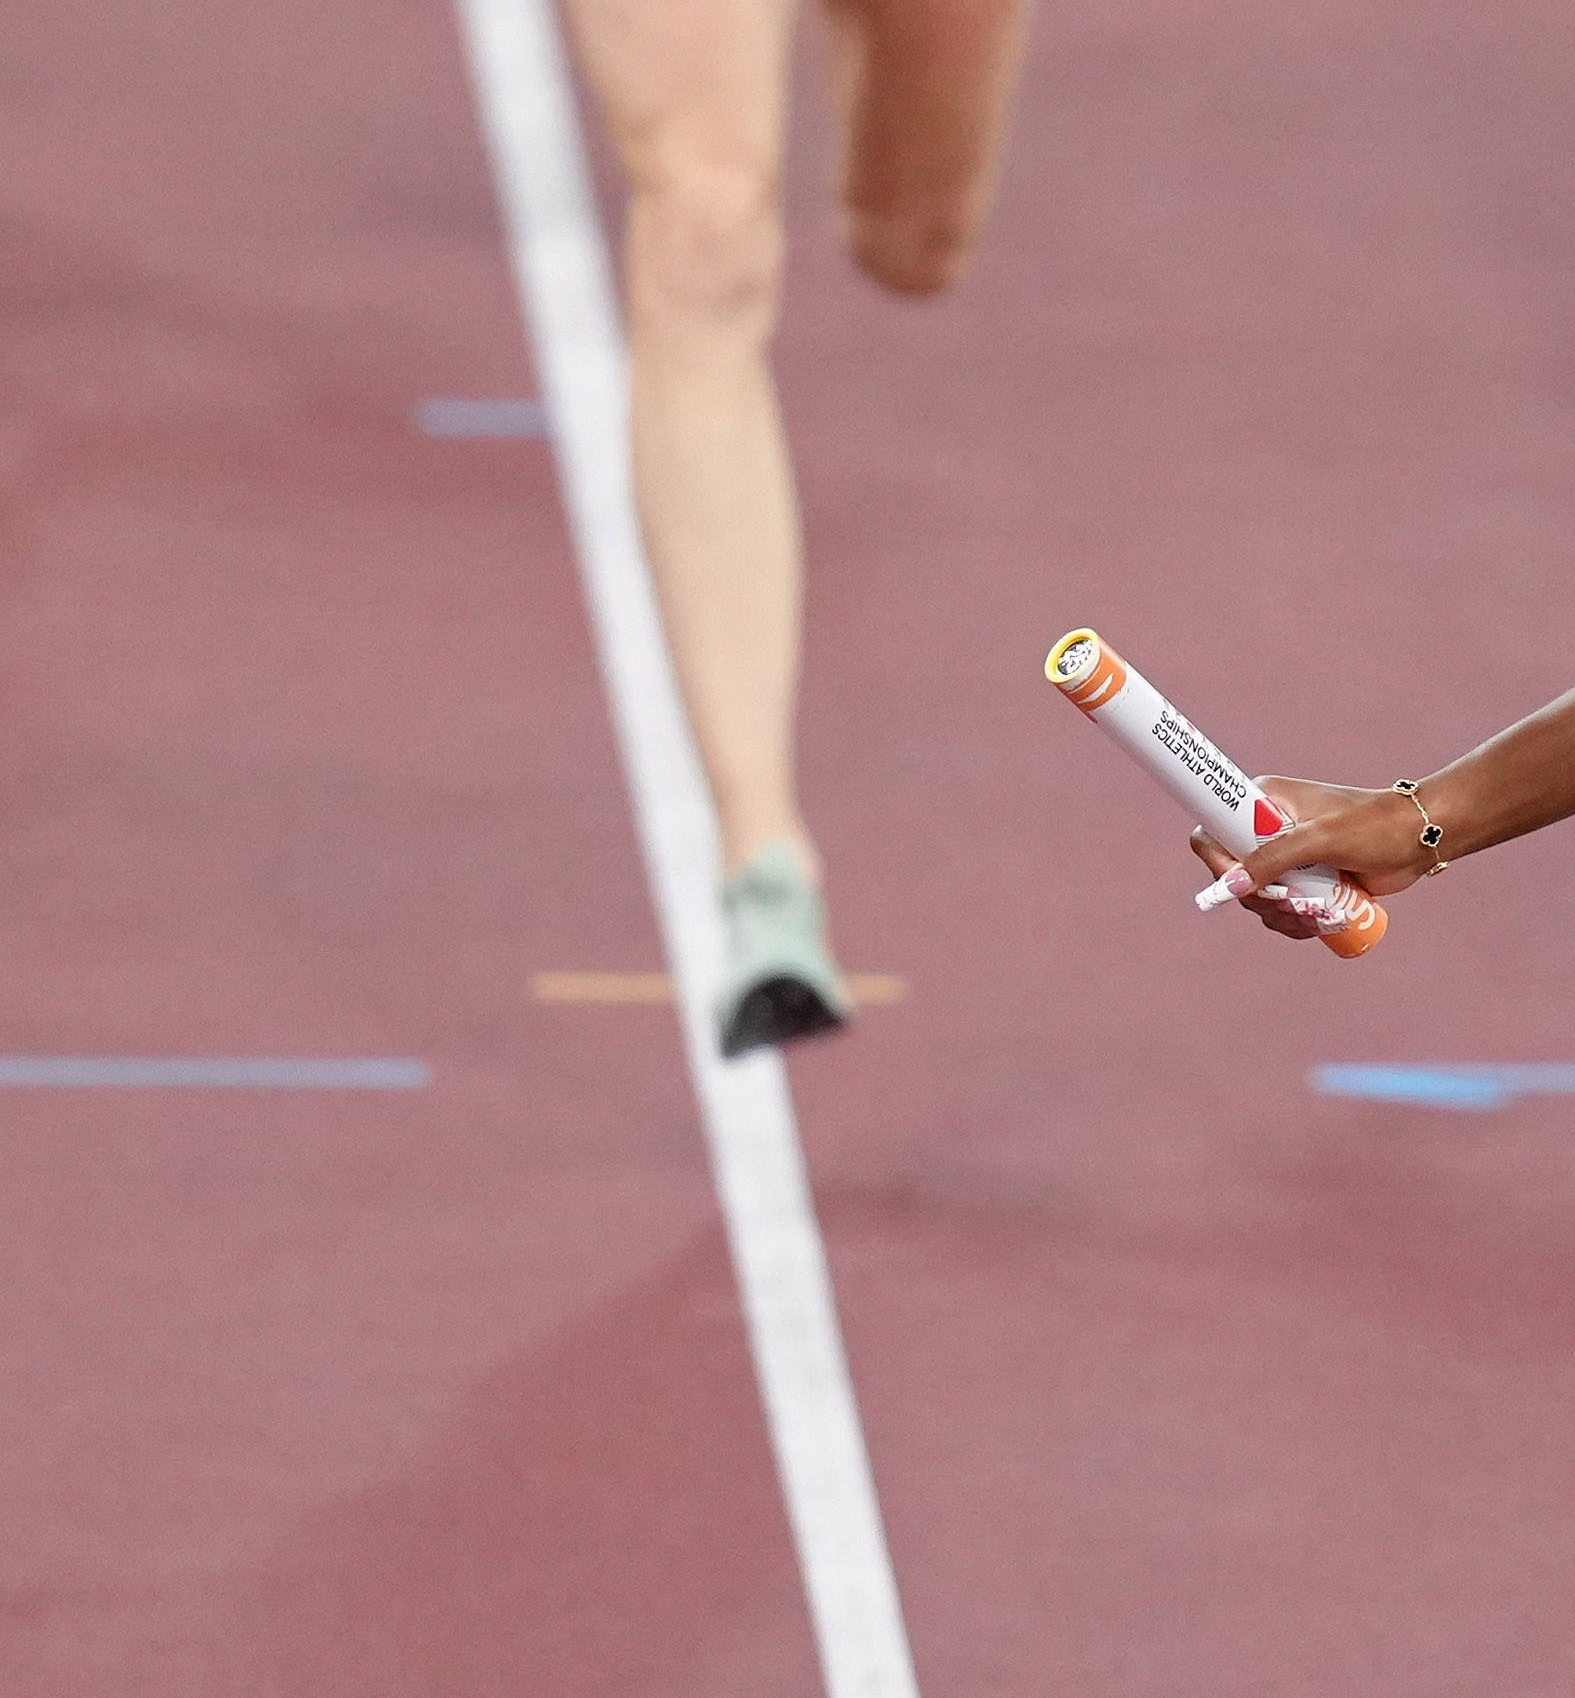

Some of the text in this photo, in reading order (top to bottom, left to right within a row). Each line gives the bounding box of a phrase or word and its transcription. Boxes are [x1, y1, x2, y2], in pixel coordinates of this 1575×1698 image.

[1151, 723, 1206, 777] ATHLETICS
[1160, 710, 1247, 799] CHAMPIONSHIPS
[1203, 773, 1240, 812] WORLD
